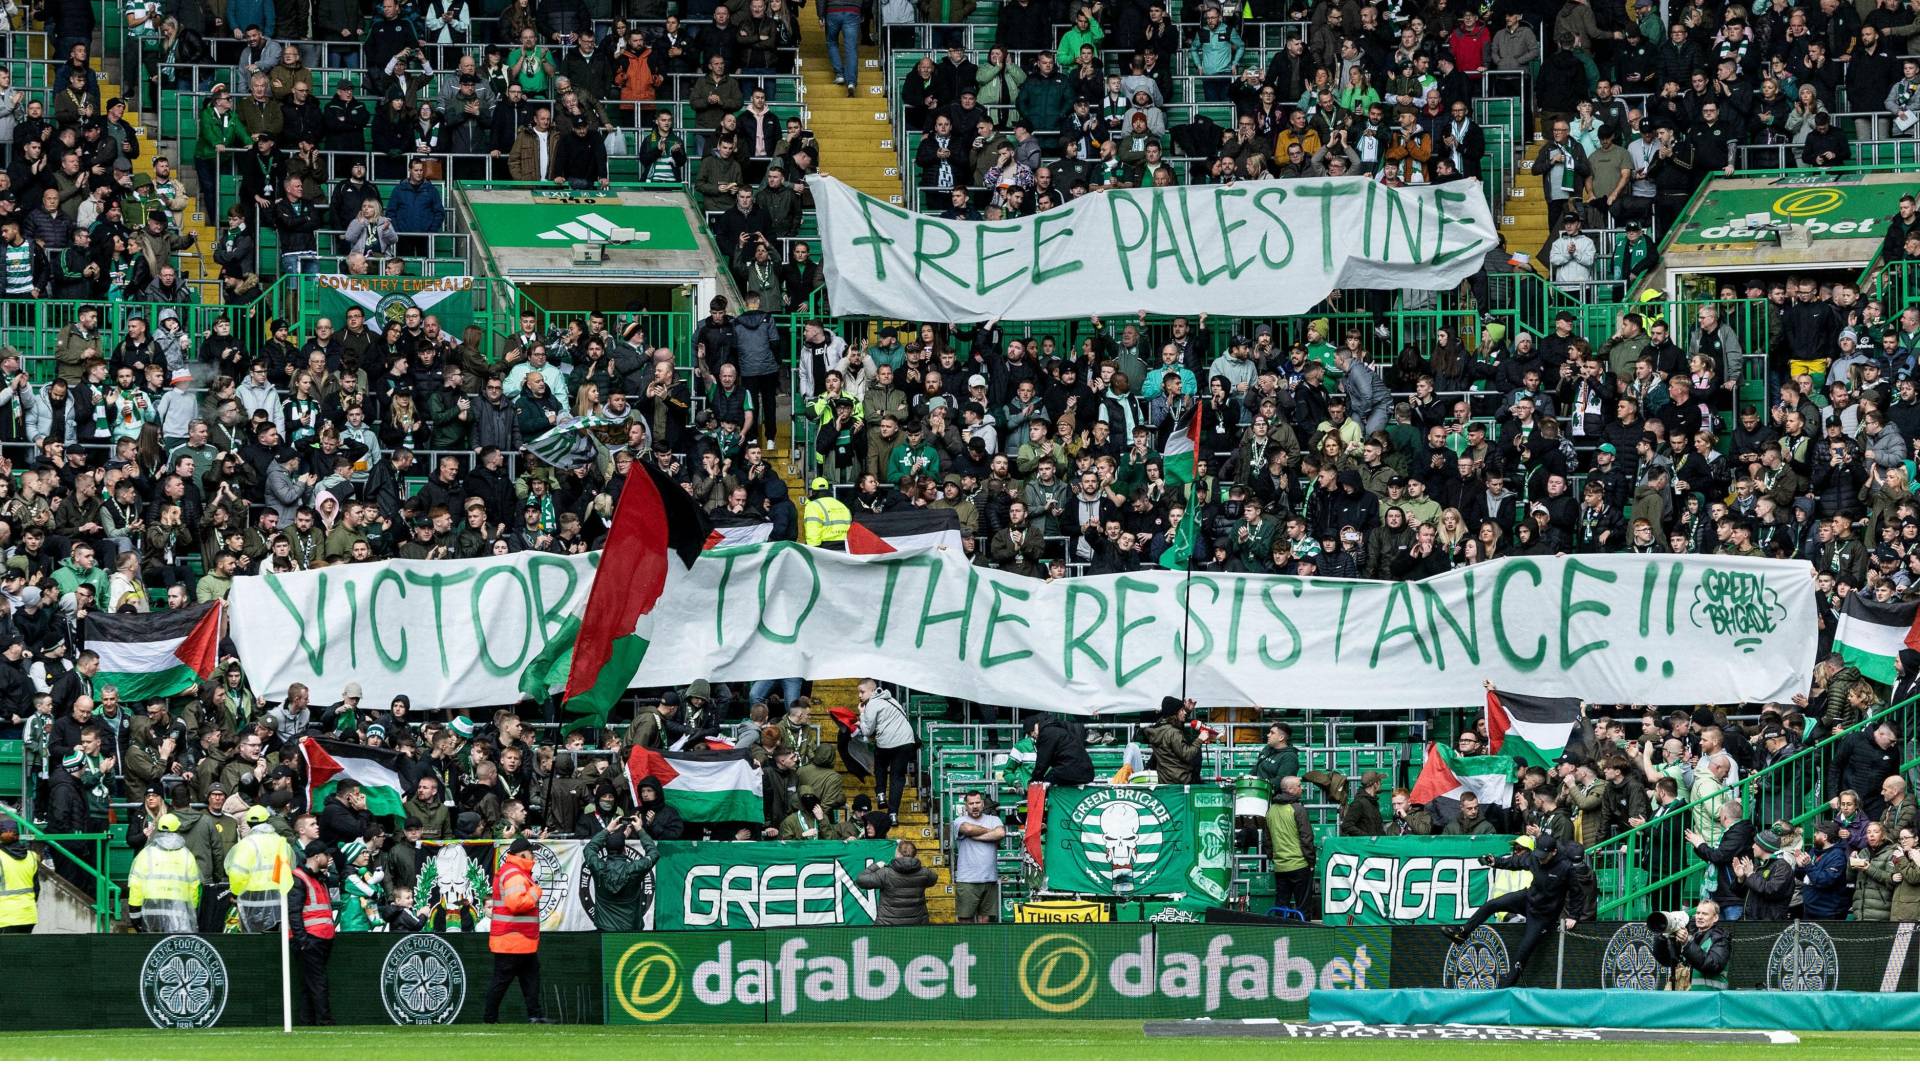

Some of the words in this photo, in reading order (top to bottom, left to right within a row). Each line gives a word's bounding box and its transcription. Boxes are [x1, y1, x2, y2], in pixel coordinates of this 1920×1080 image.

[851, 190, 1084, 297] FREE
[1106, 180, 1485, 292] PALESTINE
[318, 274, 399, 292] COVENTRY
[402, 275, 474, 292] EMERALD
[1701, 567, 1767, 606] GREEN
[265, 549, 602, 678] VICTOR
[701, 539, 821, 646] TO
[873, 554, 1034, 668] THE
[1702, 601, 1777, 636] BRIGADE
[1072, 789, 1111, 823] GREEN
[1114, 788, 1172, 824] BRIGADE
[684, 857, 879, 929] GREEN
[1324, 852, 1498, 920] BRIGAD
[1027, 911, 1062, 923] THIS
[1066, 913, 1080, 923] IS
[1083, 912, 1094, 923] A
[1157, 907, 1193, 919] JENIN
[173, 939, 213, 963] FOOTBALL
[412, 937, 453, 961] FOOTBALL
[692, 935, 977, 1016] dafabet
[1108, 932, 1372, 1012] dafabet
